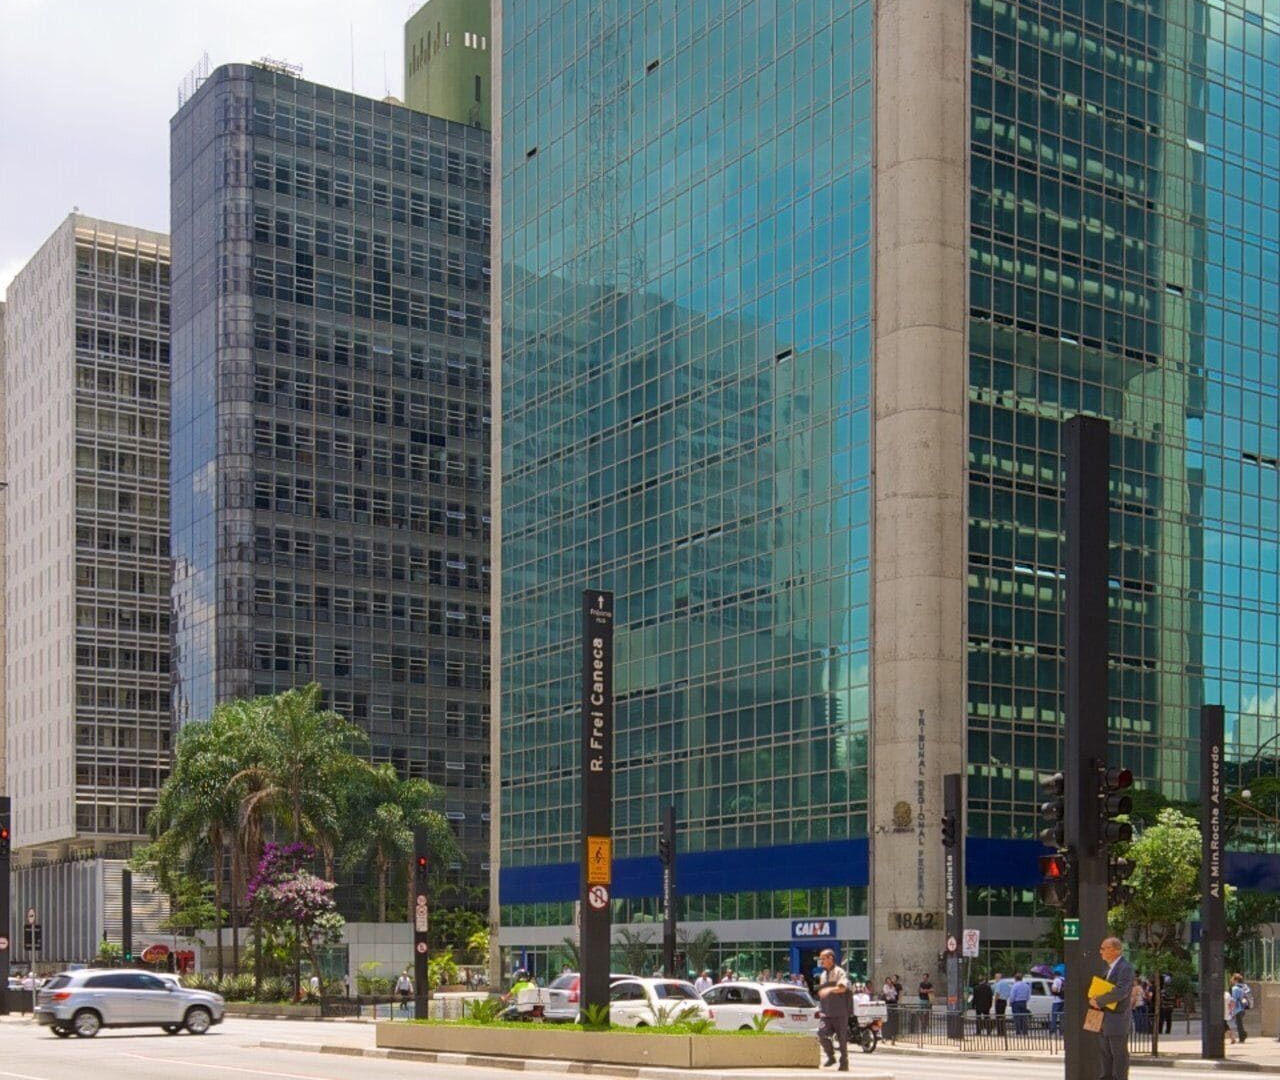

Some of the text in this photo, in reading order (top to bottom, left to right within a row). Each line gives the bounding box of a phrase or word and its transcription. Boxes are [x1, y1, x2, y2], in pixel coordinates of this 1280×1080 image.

[590, 637, 604, 771] R. Frei Caneca
[1210, 745, 1219, 804] Azevedo
[917, 780, 925, 846] REGIONAL
[917, 850, 925, 908] FEDERAL
[795, 921, 831, 937] CAIXA
[895, 912, 934, 930] 1842
